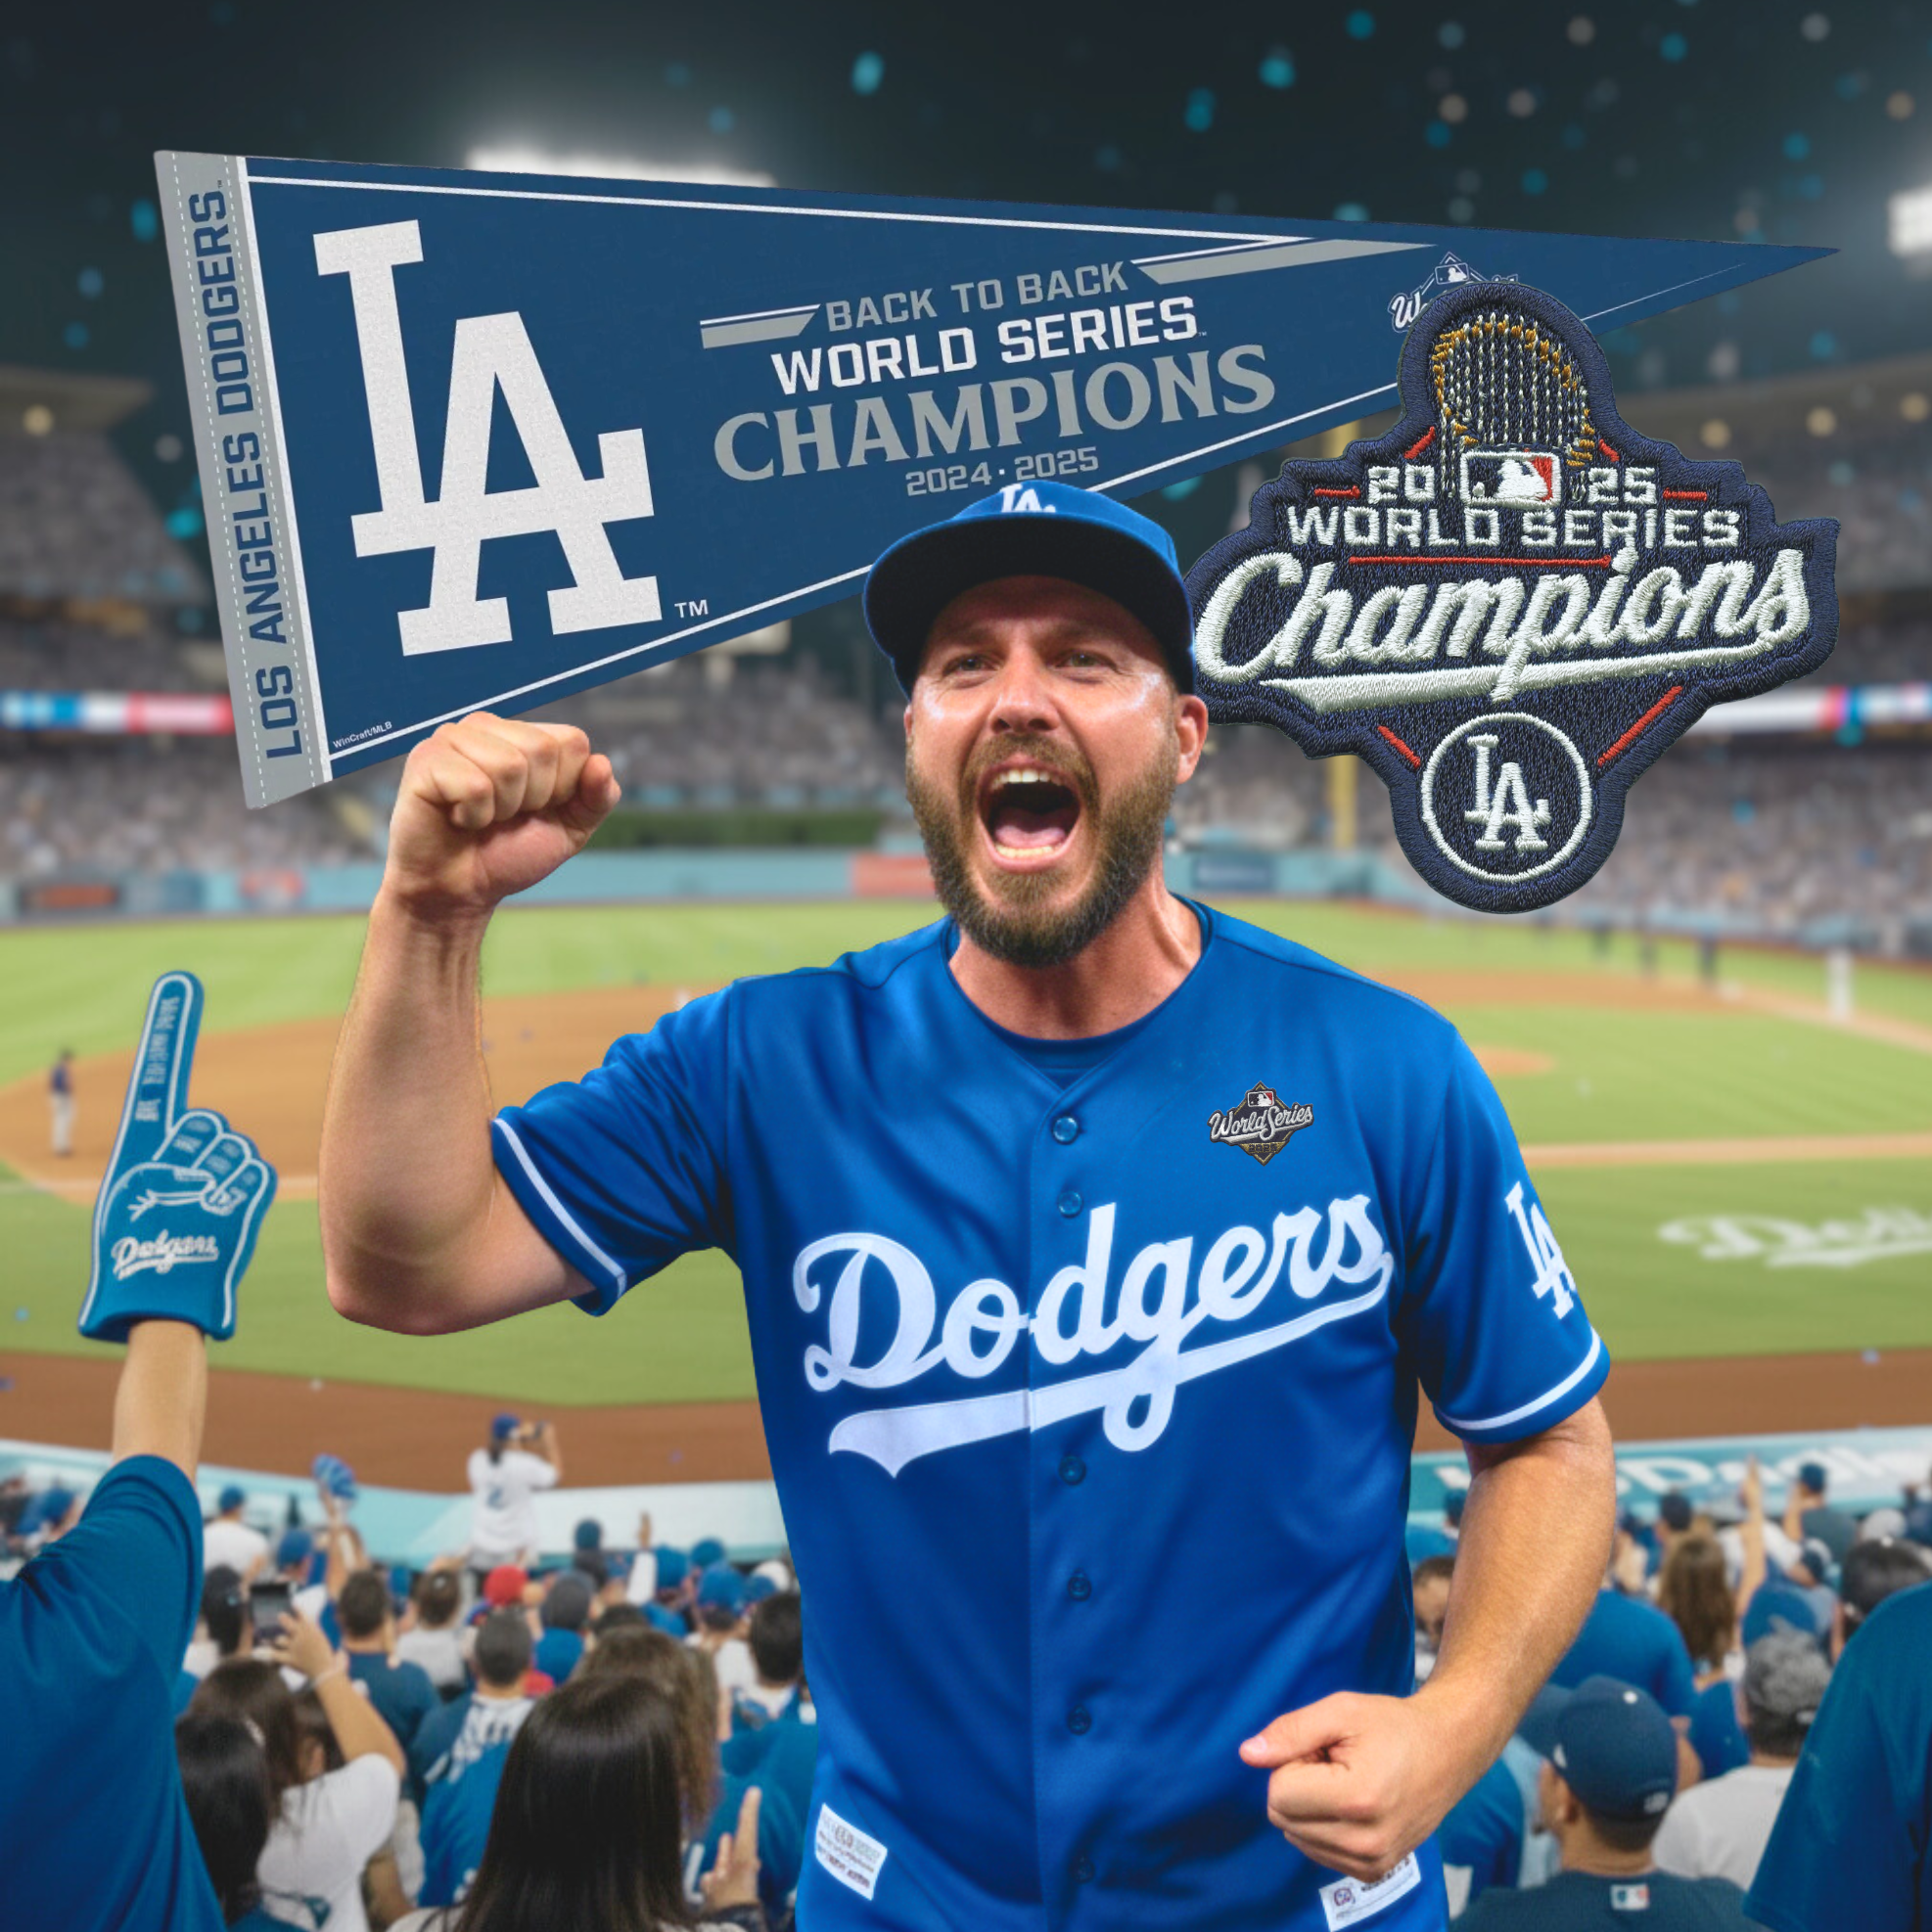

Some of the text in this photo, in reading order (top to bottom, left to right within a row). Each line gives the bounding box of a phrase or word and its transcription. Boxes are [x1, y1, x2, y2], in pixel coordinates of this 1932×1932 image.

[770, 296, 1199, 396] WORLD SERIES
[825, 260, 1129, 333] BACK TO BACK
[189, 190, 302, 759] LOS ANGELES DODGERS
[312, 219, 663, 657] LA
[713, 344, 1276, 482] CHAMPIONS
[1286, 506, 1741, 549] WORLD SERIES
[1194, 541, 1811, 703] Champions
[1463, 733, 1552, 852] LA
[1208, 1105, 1313, 1142] World Series
[792, 1193, 1395, 1452] Dodgers
